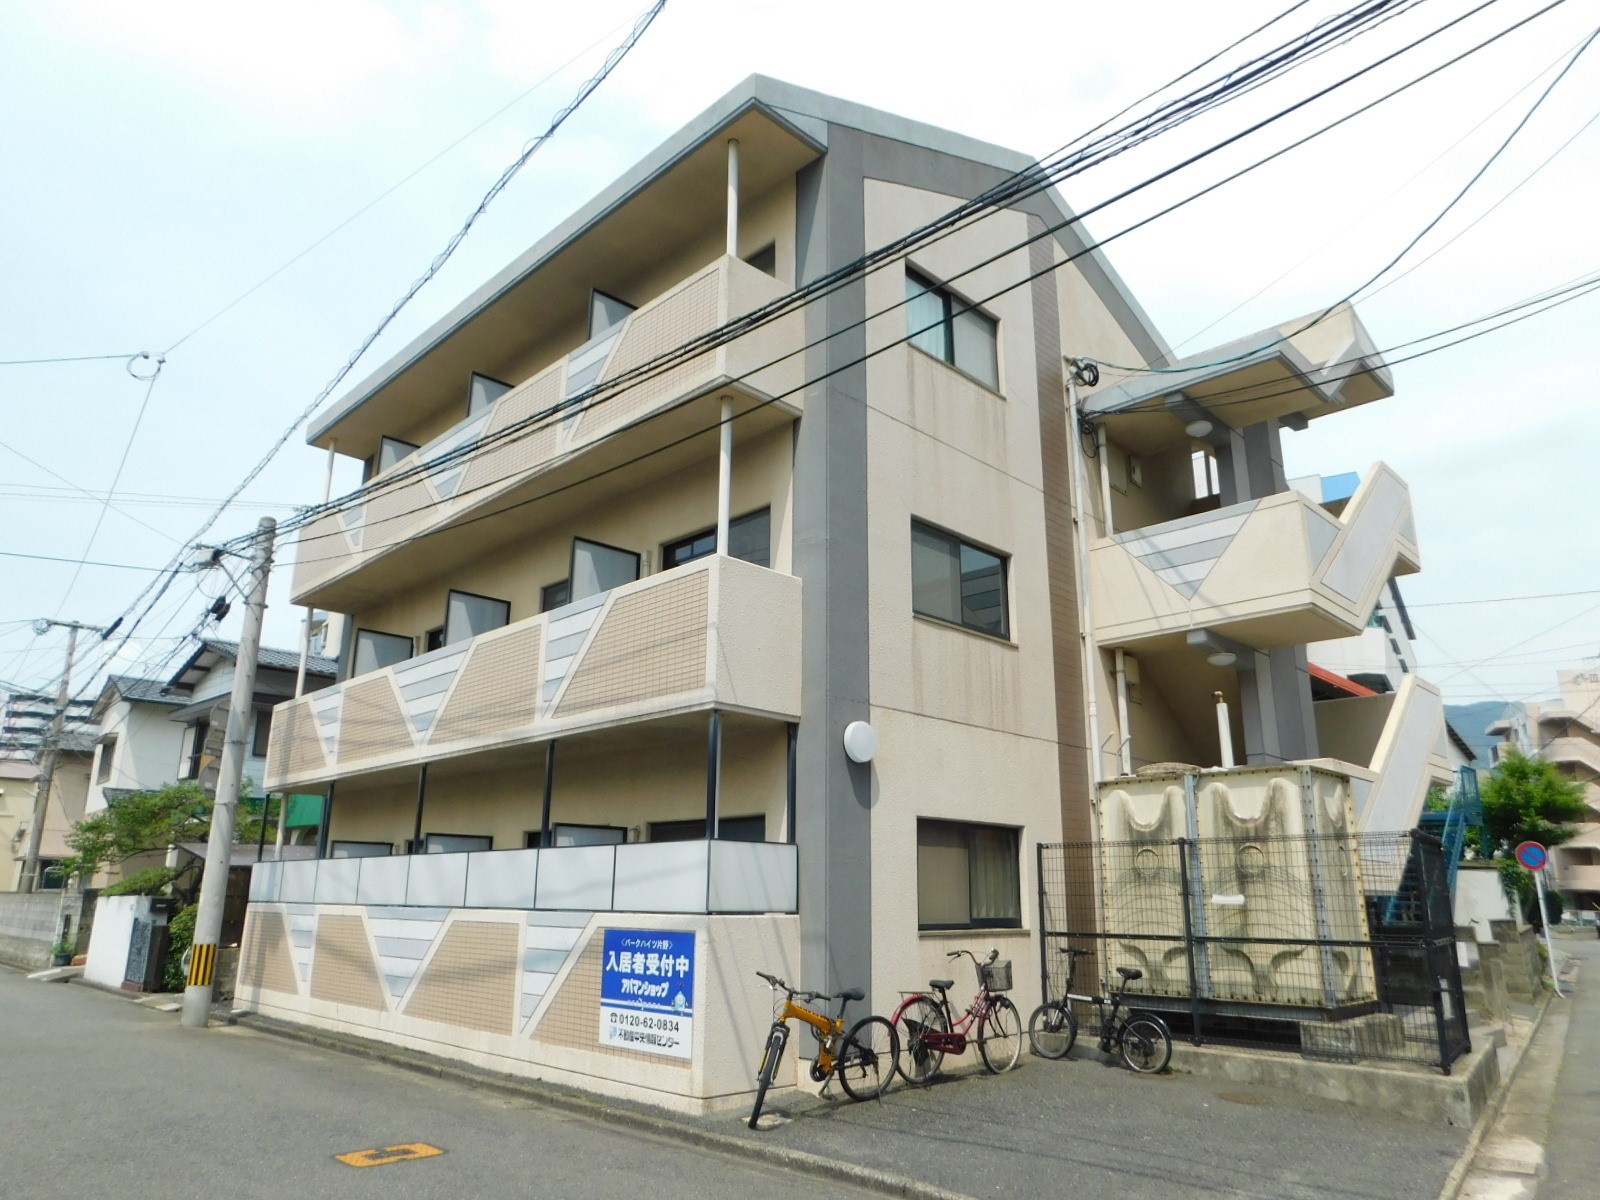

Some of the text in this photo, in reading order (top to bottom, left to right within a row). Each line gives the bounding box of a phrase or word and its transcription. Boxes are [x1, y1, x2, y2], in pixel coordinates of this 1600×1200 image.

[605, 951, 690, 978] 入居者受付中
[621, 978, 669, 998] アパマンショップ
[619, 1014, 679, 1033] 0120-62-0834
